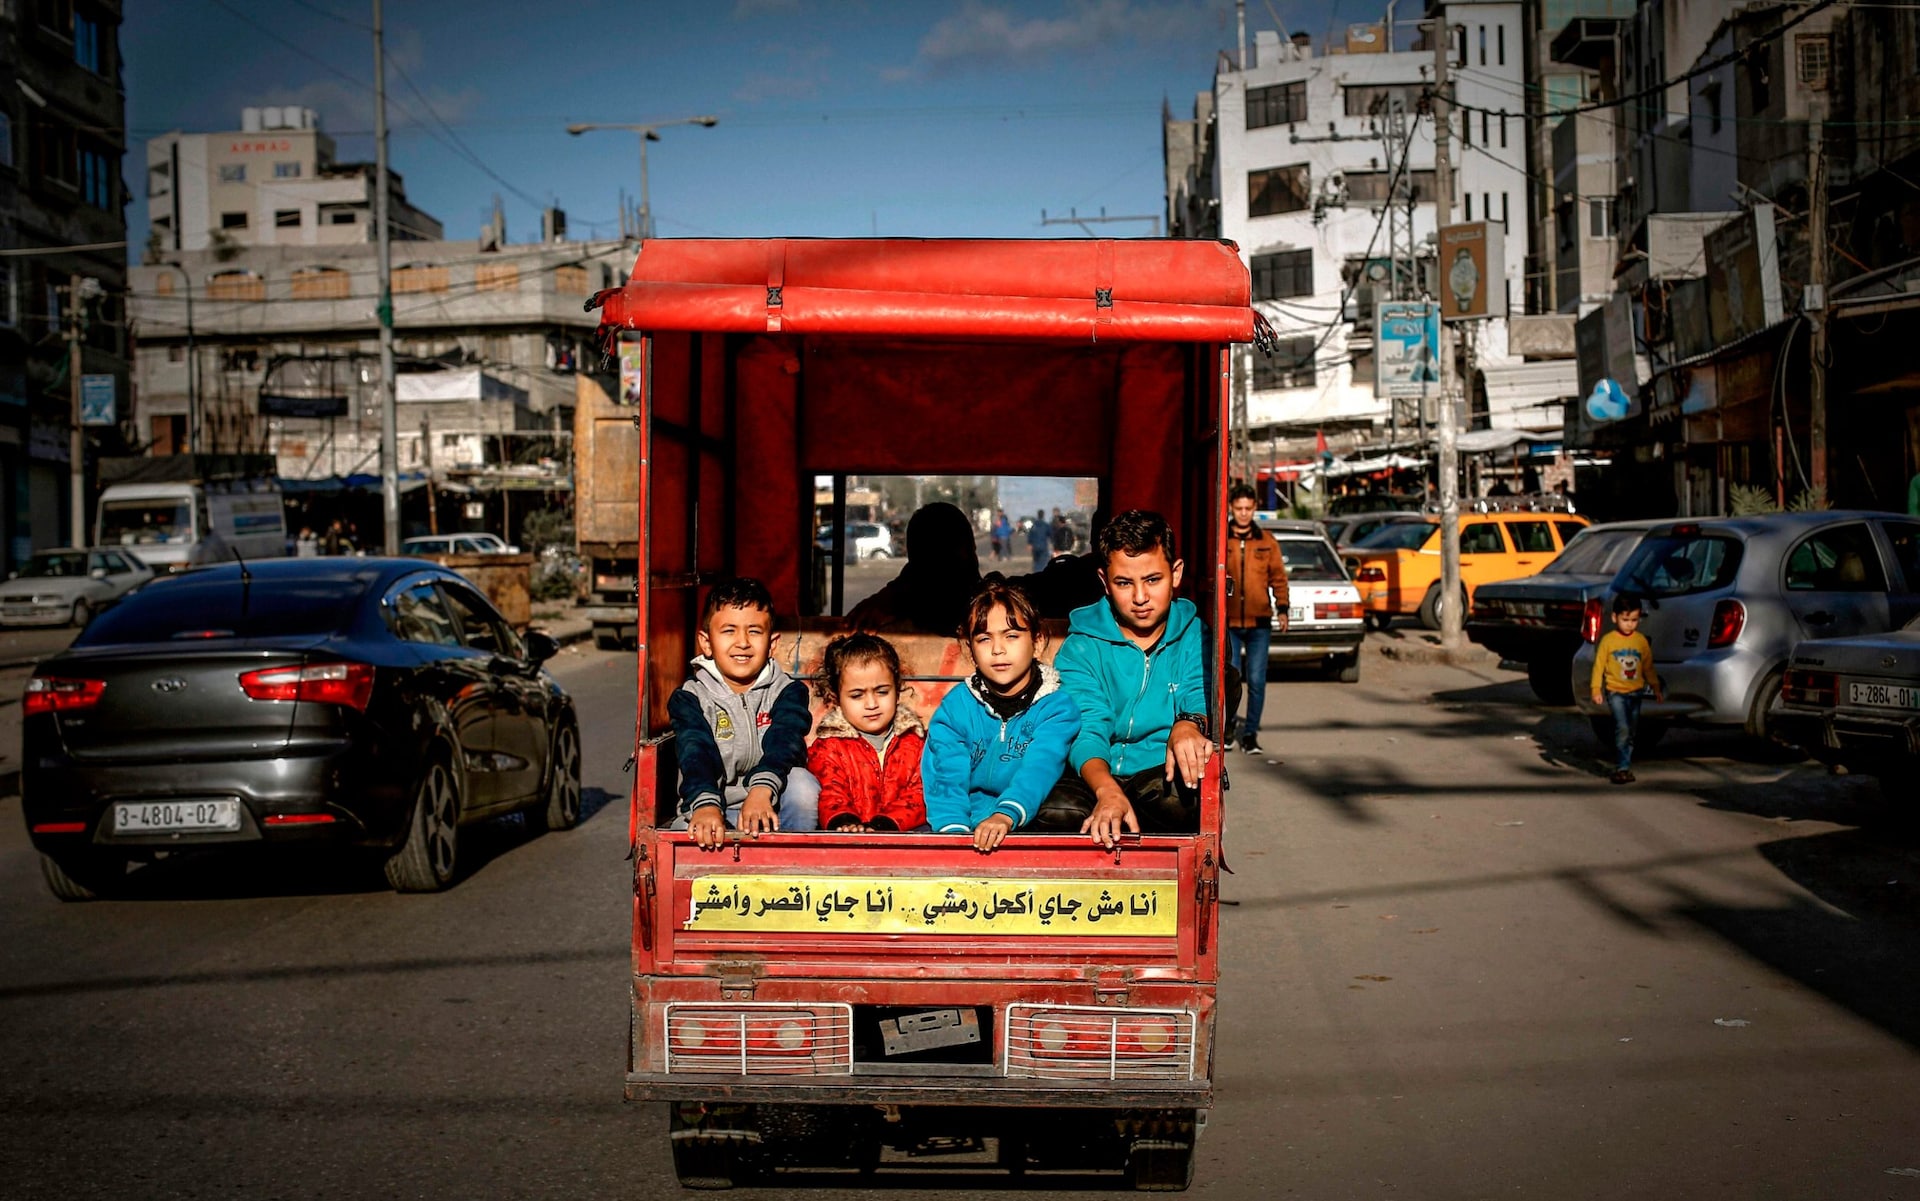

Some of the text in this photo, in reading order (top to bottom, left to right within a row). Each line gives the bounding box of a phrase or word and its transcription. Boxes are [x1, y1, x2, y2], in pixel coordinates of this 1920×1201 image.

[119, 804, 217, 826] 3-4804-02
[753, 885, 810, 917] أقصر
[815, 890, 859, 921] جاي
[866, 886, 893, 912] أنا
[923, 888, 979, 925] رمشي
[983, 889, 1033, 919] أكحل
[1038, 893, 1082, 925] جاي
[1087, 890, 1124, 921] مش
[1130, 890, 1157, 916] أنا
